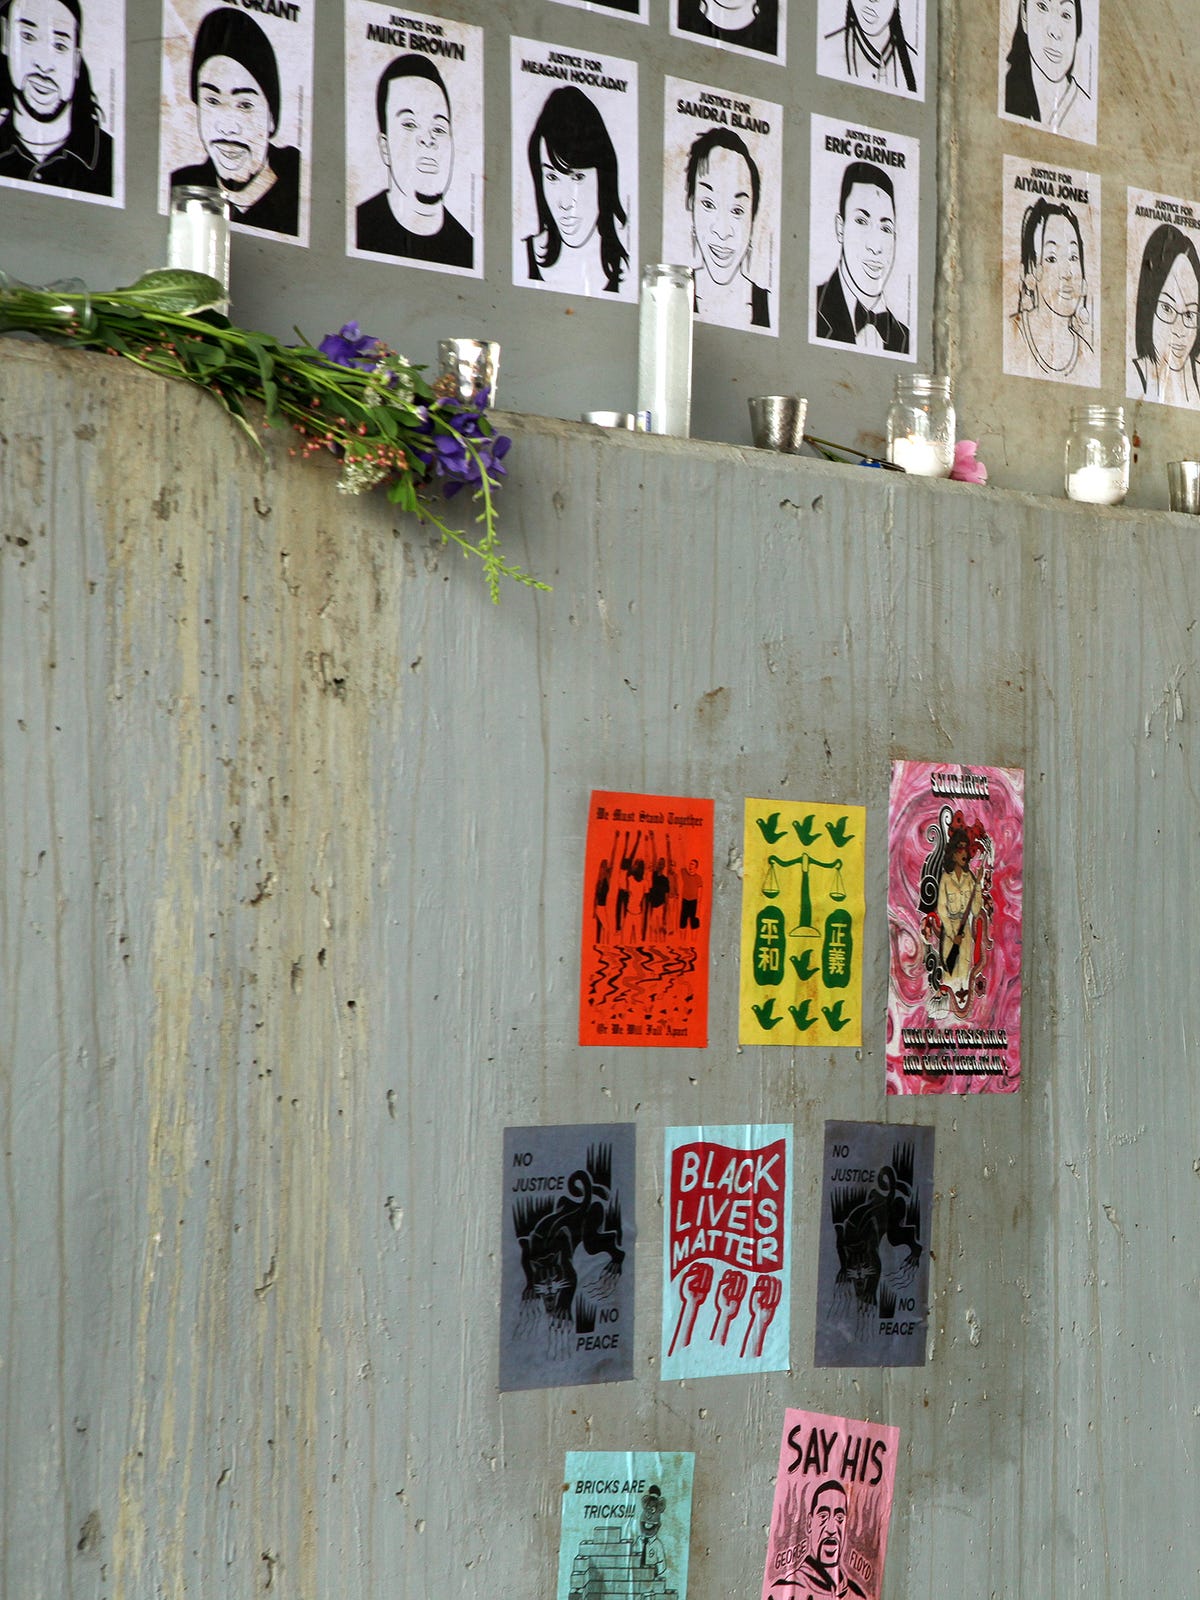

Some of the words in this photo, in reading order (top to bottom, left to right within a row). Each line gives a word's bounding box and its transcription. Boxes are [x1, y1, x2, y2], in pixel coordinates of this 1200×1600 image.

[389, 14, 425, 33] JUSTICE
[425, 22, 445, 36] FOR
[366, 23, 407, 48] MIKE
[409, 32, 466, 62] BROWN
[548, 51, 582, 69] JUSTICE
[584, 57, 603, 73] FOR
[521, 59, 568, 81] MEAGAN
[570, 68, 629, 94] HOCKADAY
[699, 92, 732, 110] JUSTICE
[734, 98, 751, 114] FOR
[676, 98, 728, 125] SANDRA
[731, 111, 770, 136] BLAND
[845, 128, 871, 143] JUSTICE
[872, 134, 887, 147] FOR
[824, 134, 851, 157] ERIC
[854, 141, 906, 169] GARNER
[1030, 166, 1057, 181] JUSTICE
[1058, 173, 1072, 185] FOR
[1014, 175, 1054, 196] AIYANA
[1056, 182, 1089, 204] JONES
[1134, 205, 1172, 224] ATATIANA
[1155, 200, 1178, 215] JUSTICE
[1179, 205, 1194, 217] FOR
[639, 810, 665, 824] Stand
[667, 812, 703, 828] Together
[758, 918, 779, 971] 平和
[828, 923, 848, 975] 正義
[513, 1152, 533, 1168] NO
[832, 1145, 849, 1159] NO
[680, 1150, 781, 1193] BLACK
[830, 1168, 876, 1184] JUSTICE
[512, 1175, 565, 1192] JUSTICE
[675, 1196, 778, 1234] LIVES
[672, 1233, 779, 1267] MATTER
[899, 1297, 915, 1312] NO
[600, 1308, 619, 1323] NO
[878, 1321, 915, 1336] PEACE
[576, 1333, 620, 1352] PEACE
[787, 1424, 838, 1475] SAY
[840, 1432, 887, 1485] HIS
[575, 1480, 620, 1494] BRICKS
[621, 1480, 646, 1494] ARE
[583, 1504, 636, 1519] TRICKS!!!
[775, 1540, 807, 1570] GEORGE
[850, 1550, 872, 1580] FLOYD
